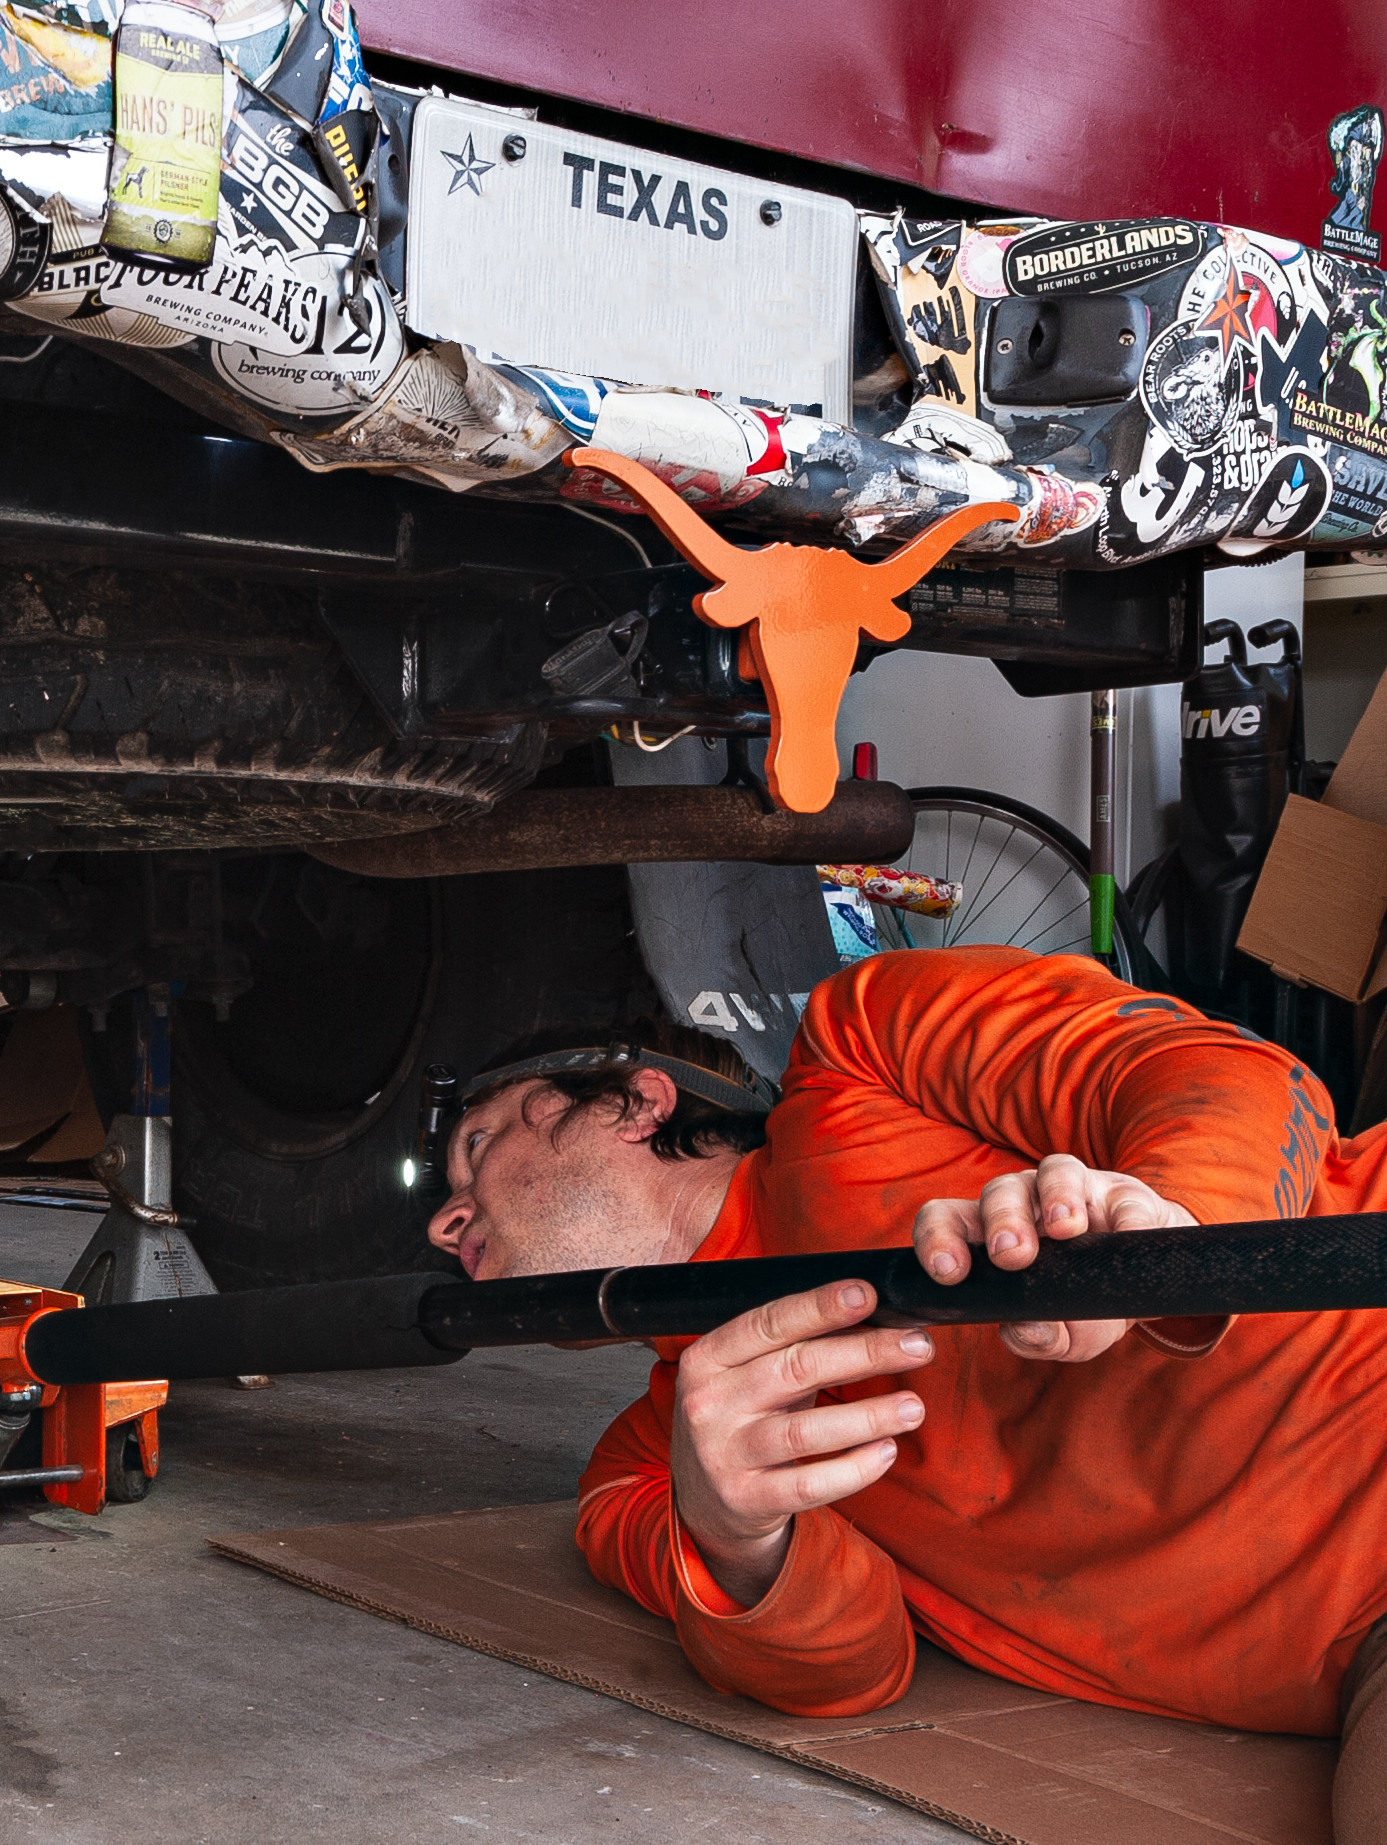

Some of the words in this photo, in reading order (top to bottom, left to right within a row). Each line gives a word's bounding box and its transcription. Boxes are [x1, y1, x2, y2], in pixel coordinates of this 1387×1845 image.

[139, 32, 174, 52] REAL
[176, 39, 201, 61] ALE
[183, 103, 218, 149] PILS
[265, 123, 295, 156] the
[160, 180, 189, 190] PILSNER
[231, 133, 330, 240] BGB
[562, 151, 728, 241] TEXAS
[73, 247, 94, 260] PUB
[1015, 225, 1194, 282] BORDERLANDS
[1036, 278, 1081, 293] BREWING
[1083, 271, 1098, 282] CO.
[1165, 252, 1178, 262] AZ
[145, 294, 202, 317] BREWING
[205, 311, 266, 335] COMPANY
[211, 264, 319, 345] PEAKS
[175, 314, 224, 334] ARIZONA
[1150, 323, 1190, 367] ROOTS
[238, 359, 307, 384] brewing
[1145, 366, 1159, 403] BEAR
[1292, 412, 1345, 441] BREWING
[1350, 493, 1384, 517] WORLD
[153, 1251, 161, 1260] 2
